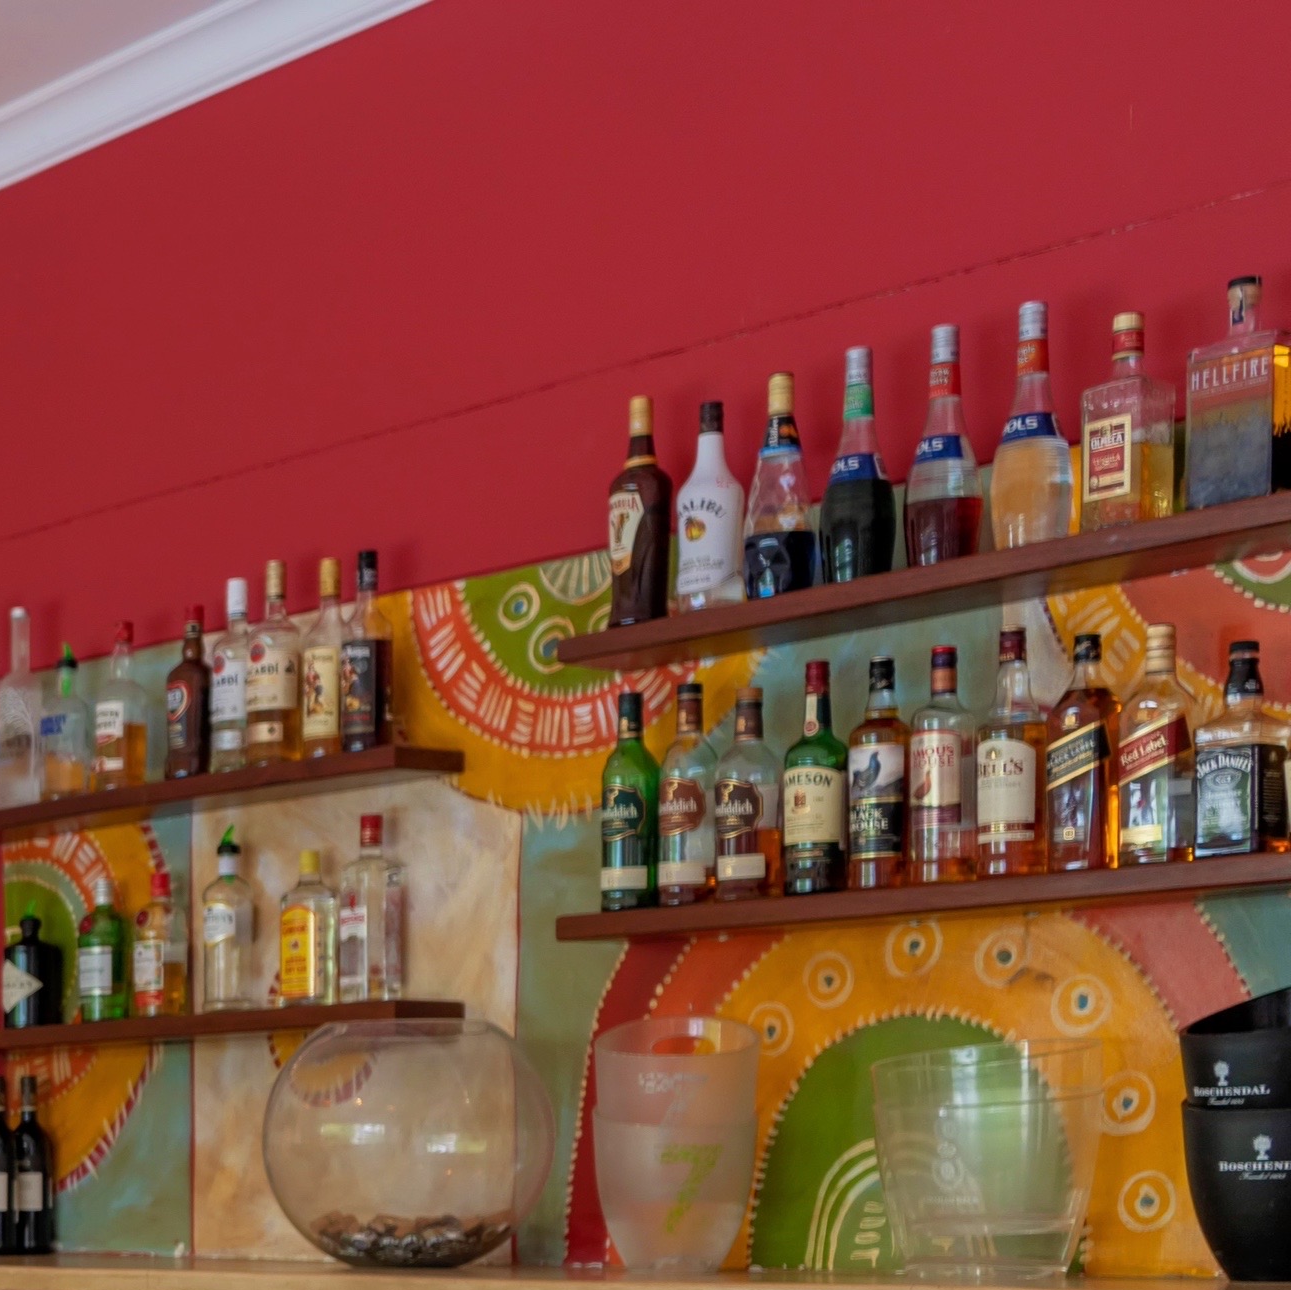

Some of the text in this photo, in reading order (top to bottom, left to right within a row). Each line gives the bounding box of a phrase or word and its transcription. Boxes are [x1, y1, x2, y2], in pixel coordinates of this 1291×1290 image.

[1191, 356, 1268, 391] HELLFIRE
[917, 437, 944, 455] OLS
[832, 456, 859, 474] OLS
[1121, 733, 1168, 767] Red Label
[1196, 759, 1218, 780] JACK
[1193, 1083, 1271, 1097] BOSCHENDAL
